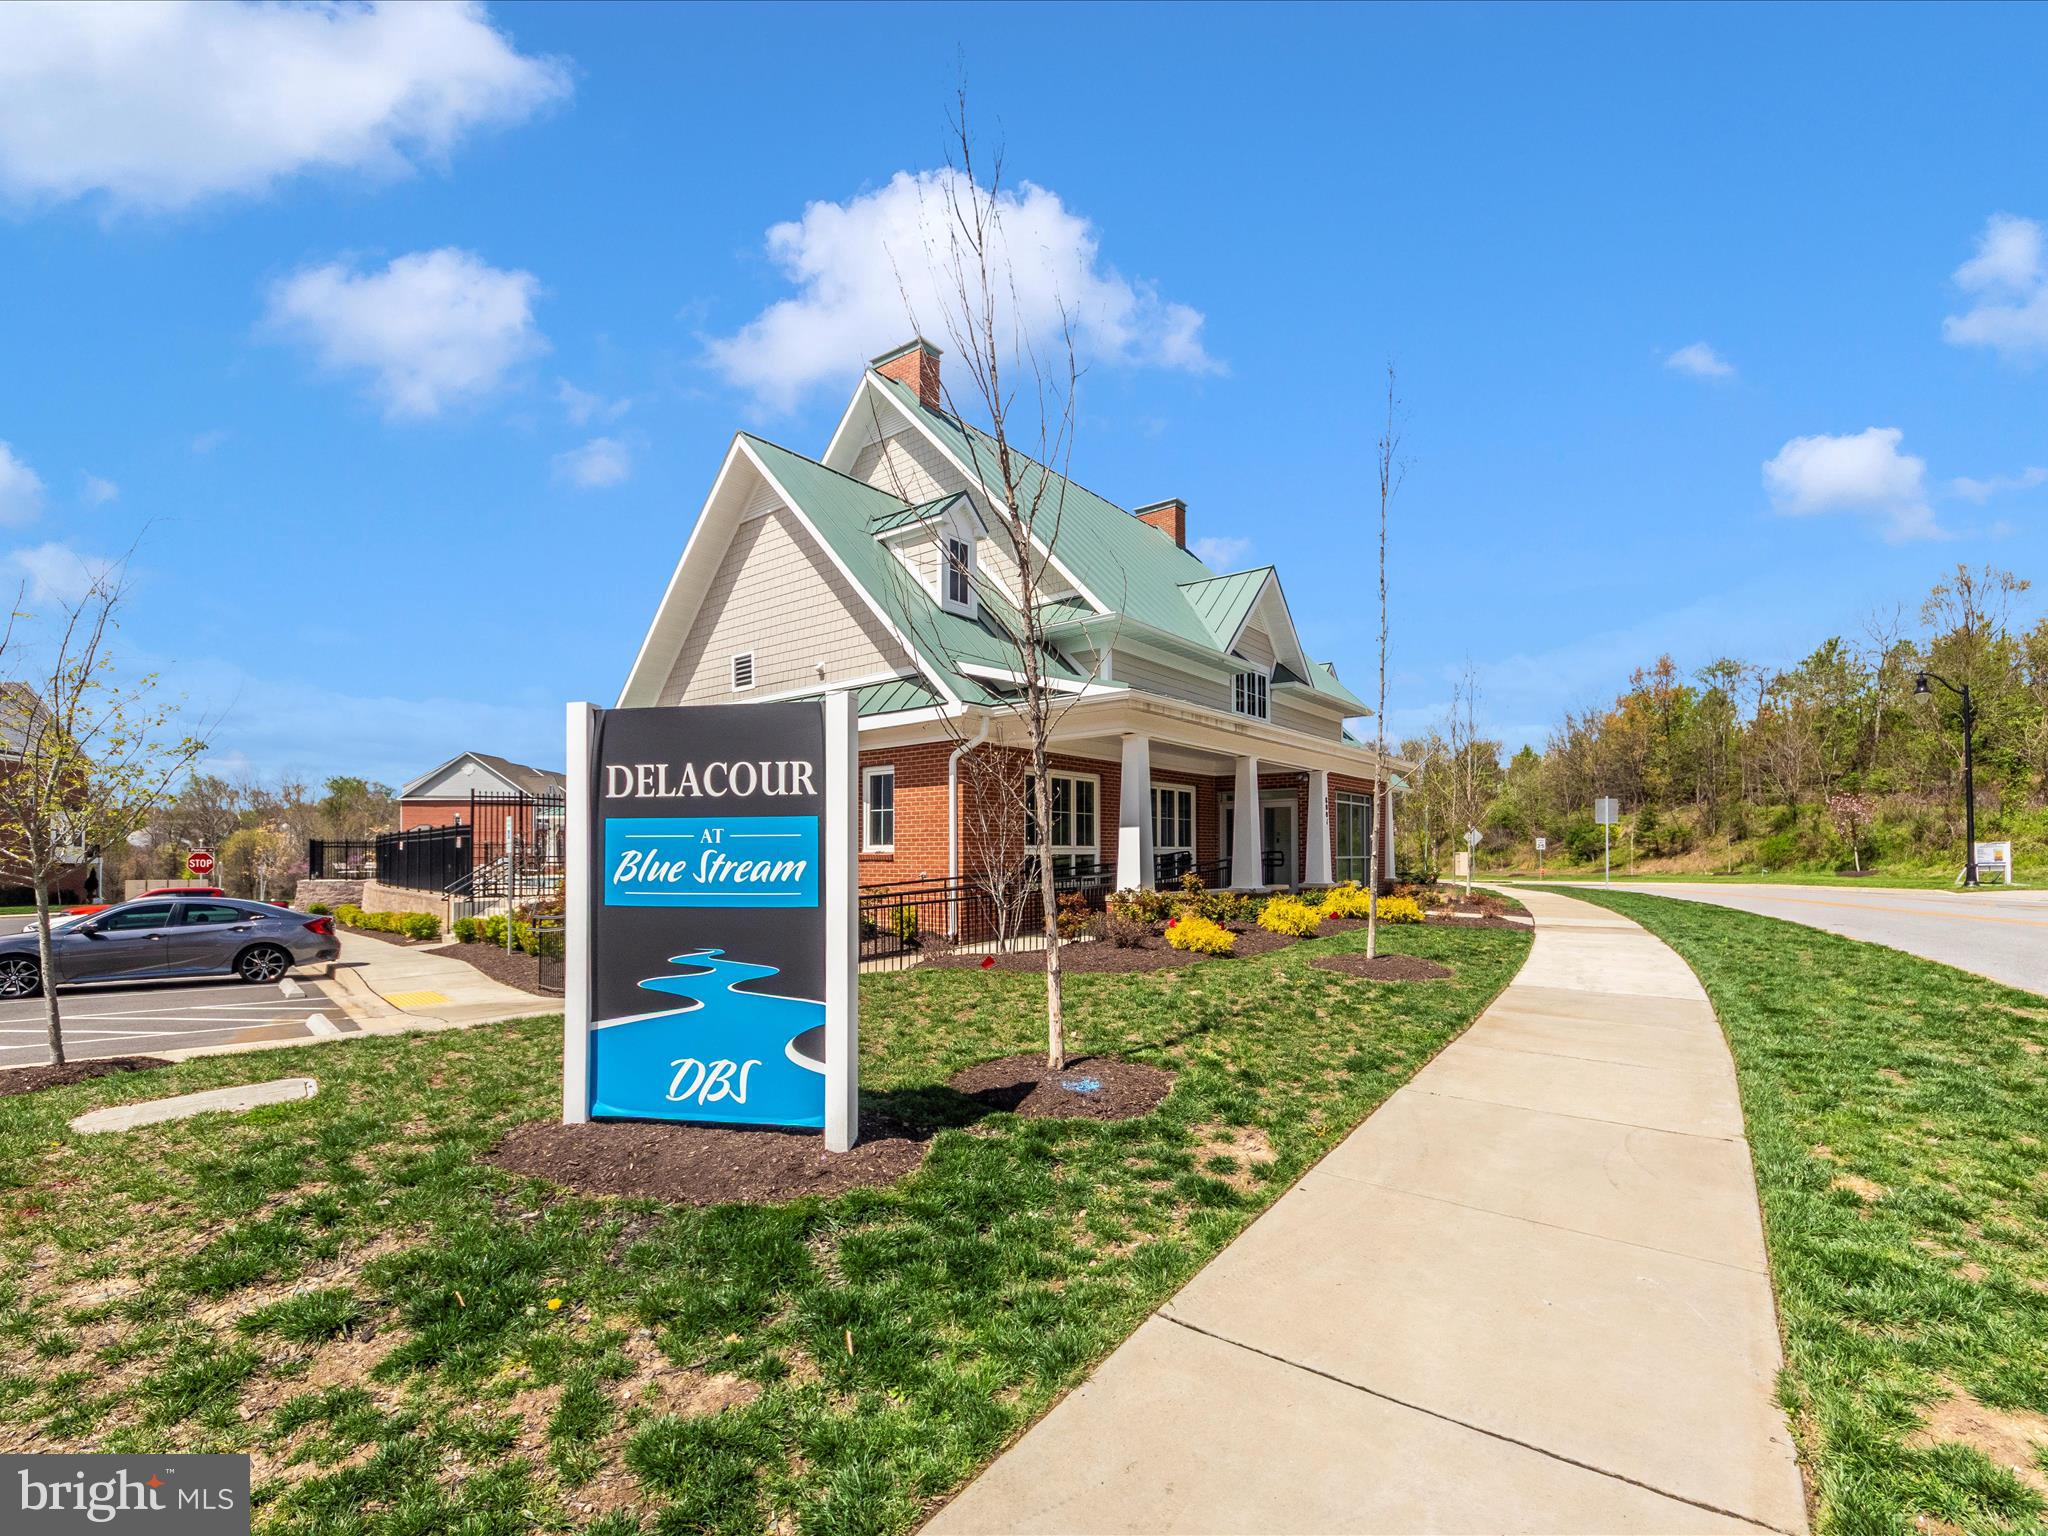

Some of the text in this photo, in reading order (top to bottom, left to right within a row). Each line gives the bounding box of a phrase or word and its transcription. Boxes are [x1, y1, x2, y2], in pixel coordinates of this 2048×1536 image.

[605, 761, 818, 798] DELACOUR
[700, 828, 724, 843] AT
[189, 859, 212, 868] STOP
[613, 849, 807, 885] Blue Stream
[665, 1058, 763, 1105] DBS
